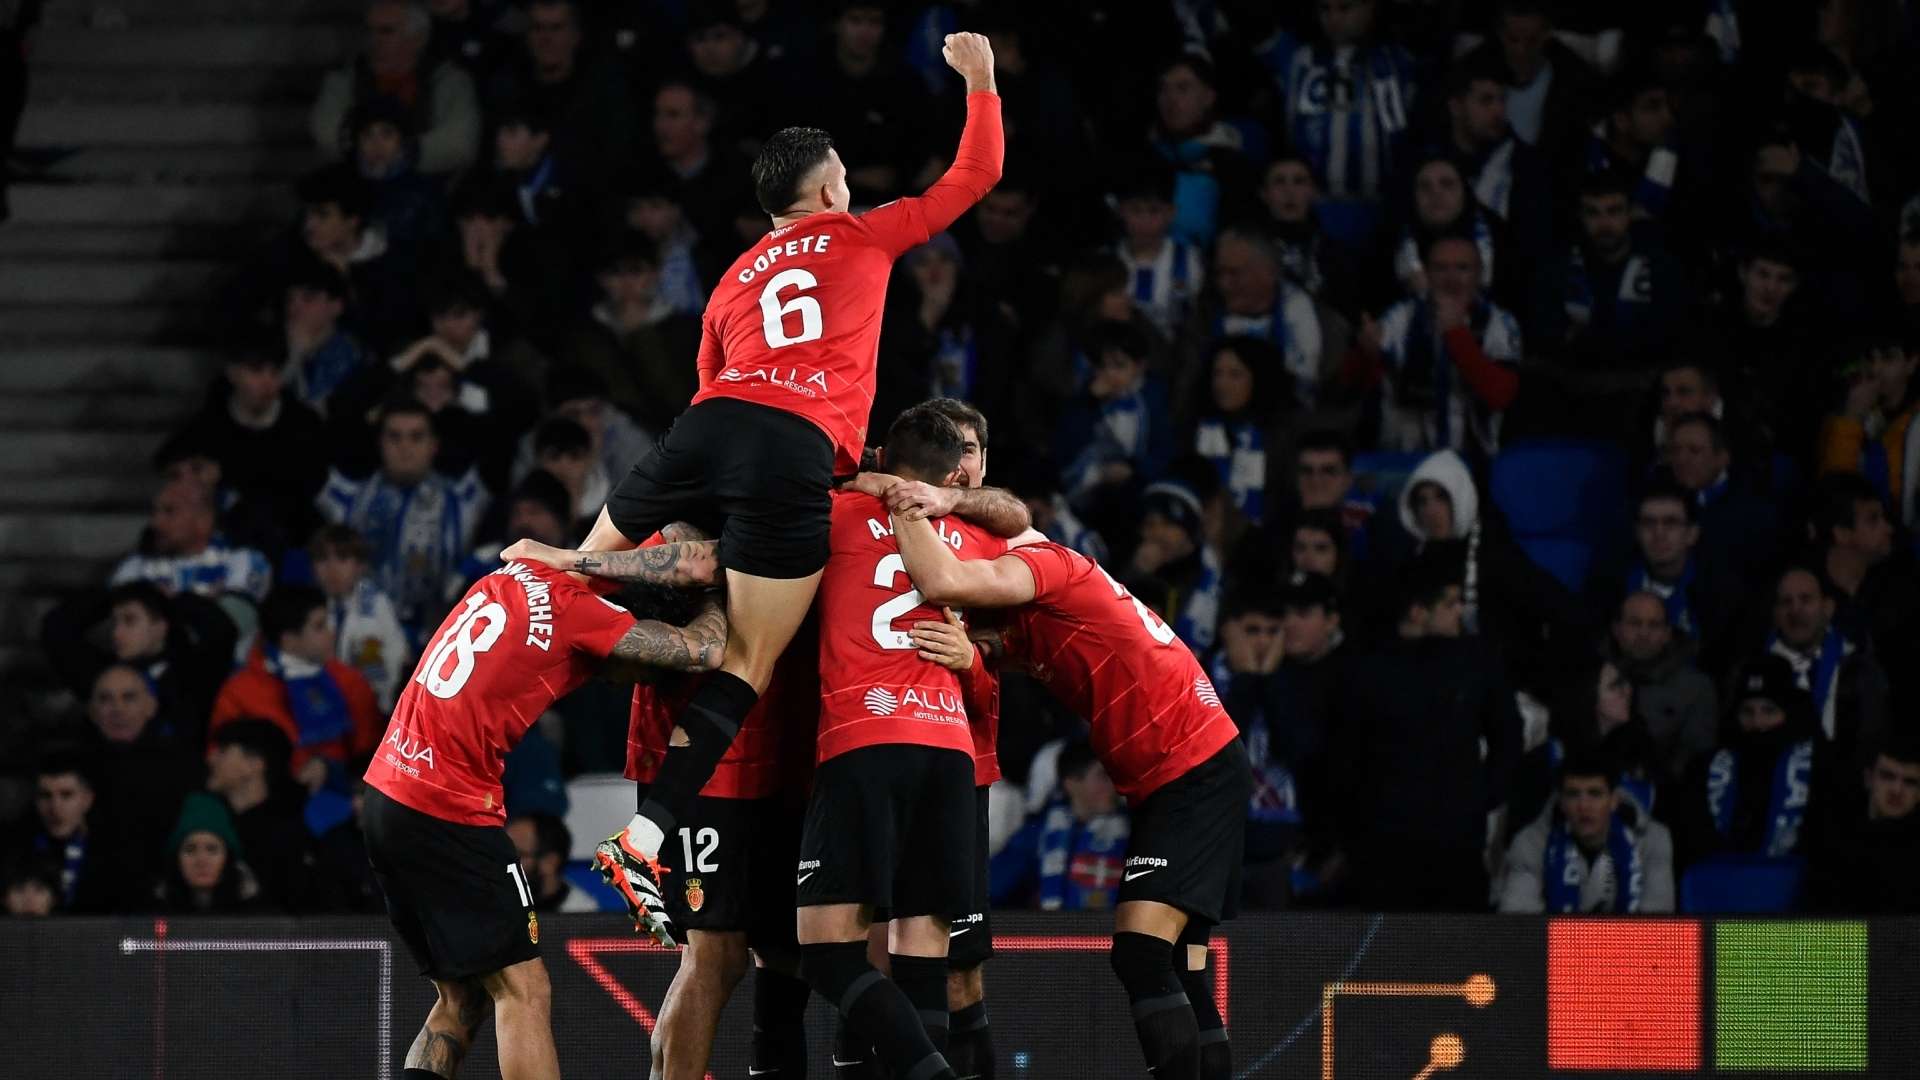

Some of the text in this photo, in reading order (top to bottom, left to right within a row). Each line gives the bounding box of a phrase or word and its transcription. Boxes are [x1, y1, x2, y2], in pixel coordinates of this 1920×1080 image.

[738, 234, 832, 284] COPETE
[758, 267, 824, 350] 6
[783, 380, 817, 398] RESORTS
[415, 591, 507, 699] 18
[903, 688, 968, 720] ALUA
[914, 711, 939, 722] HOTELS
[678, 826, 720, 874] 12
